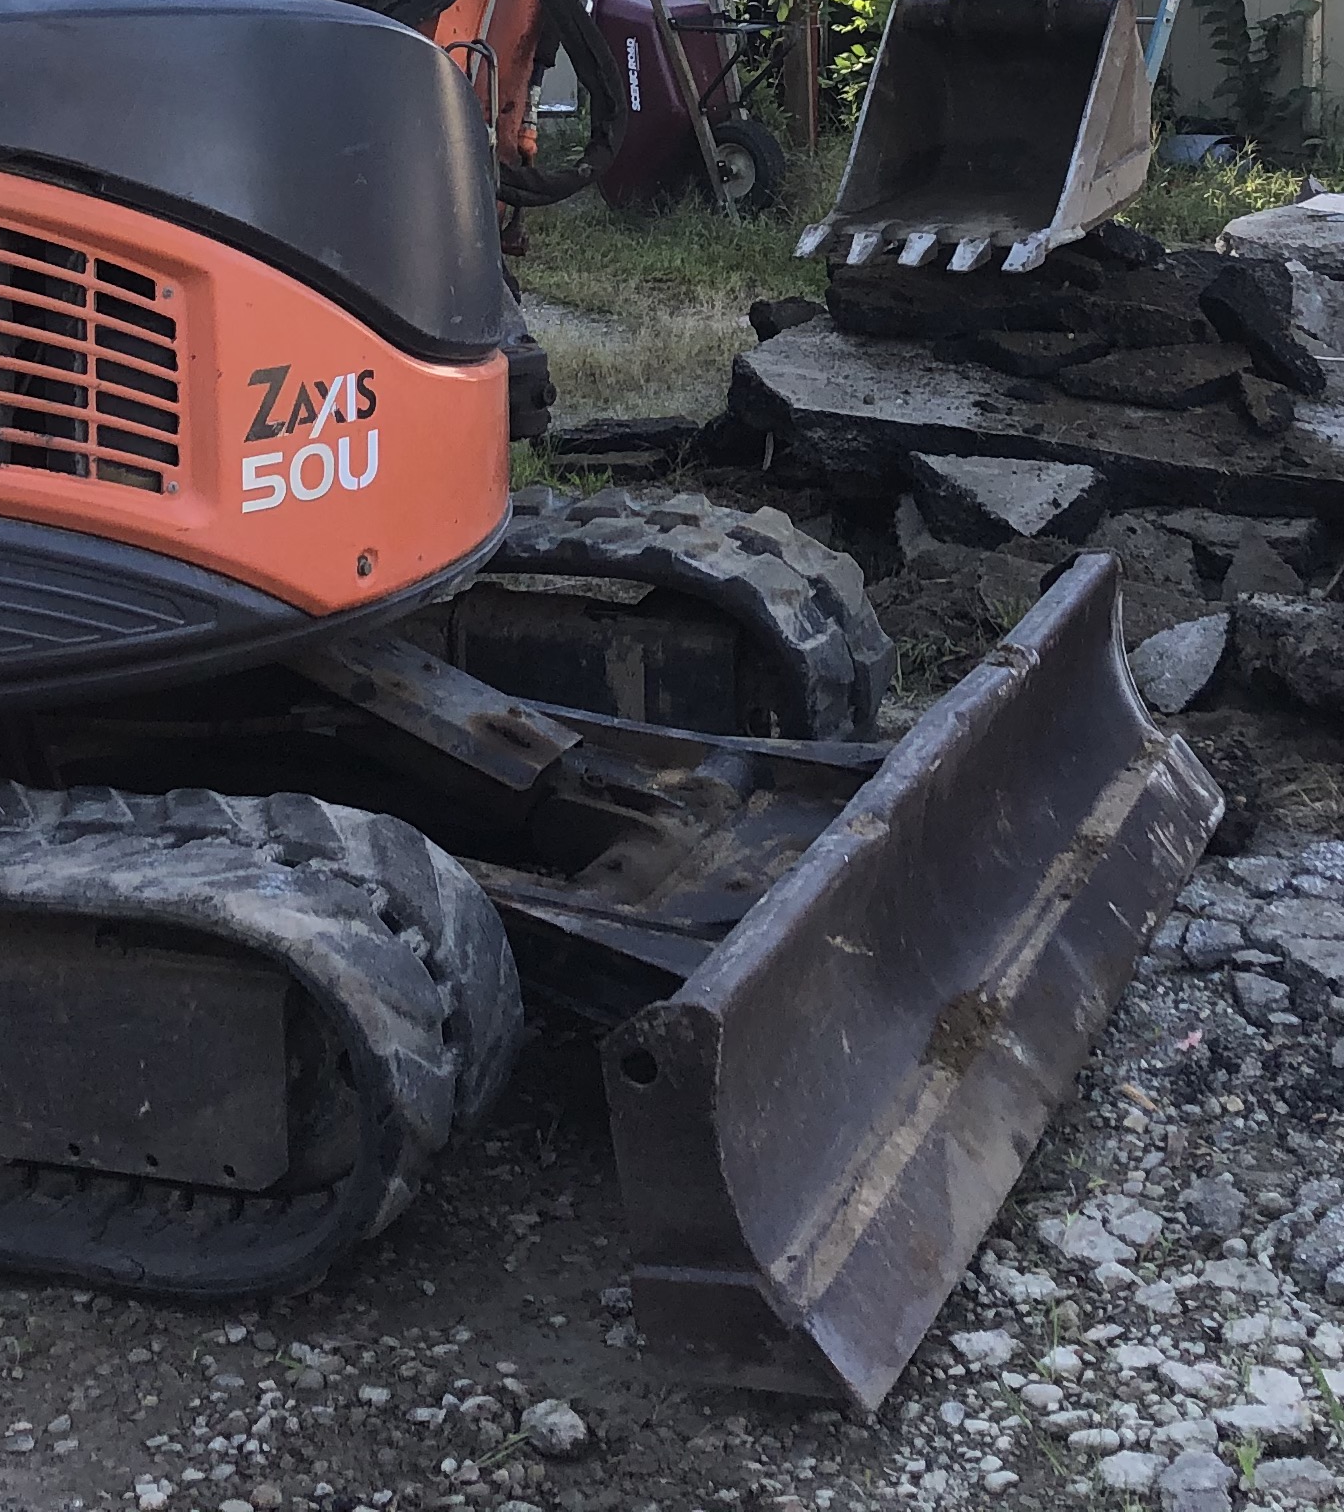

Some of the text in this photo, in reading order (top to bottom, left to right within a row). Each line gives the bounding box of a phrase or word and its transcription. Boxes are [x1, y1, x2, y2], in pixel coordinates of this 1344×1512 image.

[626, 37, 641, 111] SCENIC ROAD
[243, 364, 377, 443] ZAXIS
[241, 428, 379, 514] 50U
